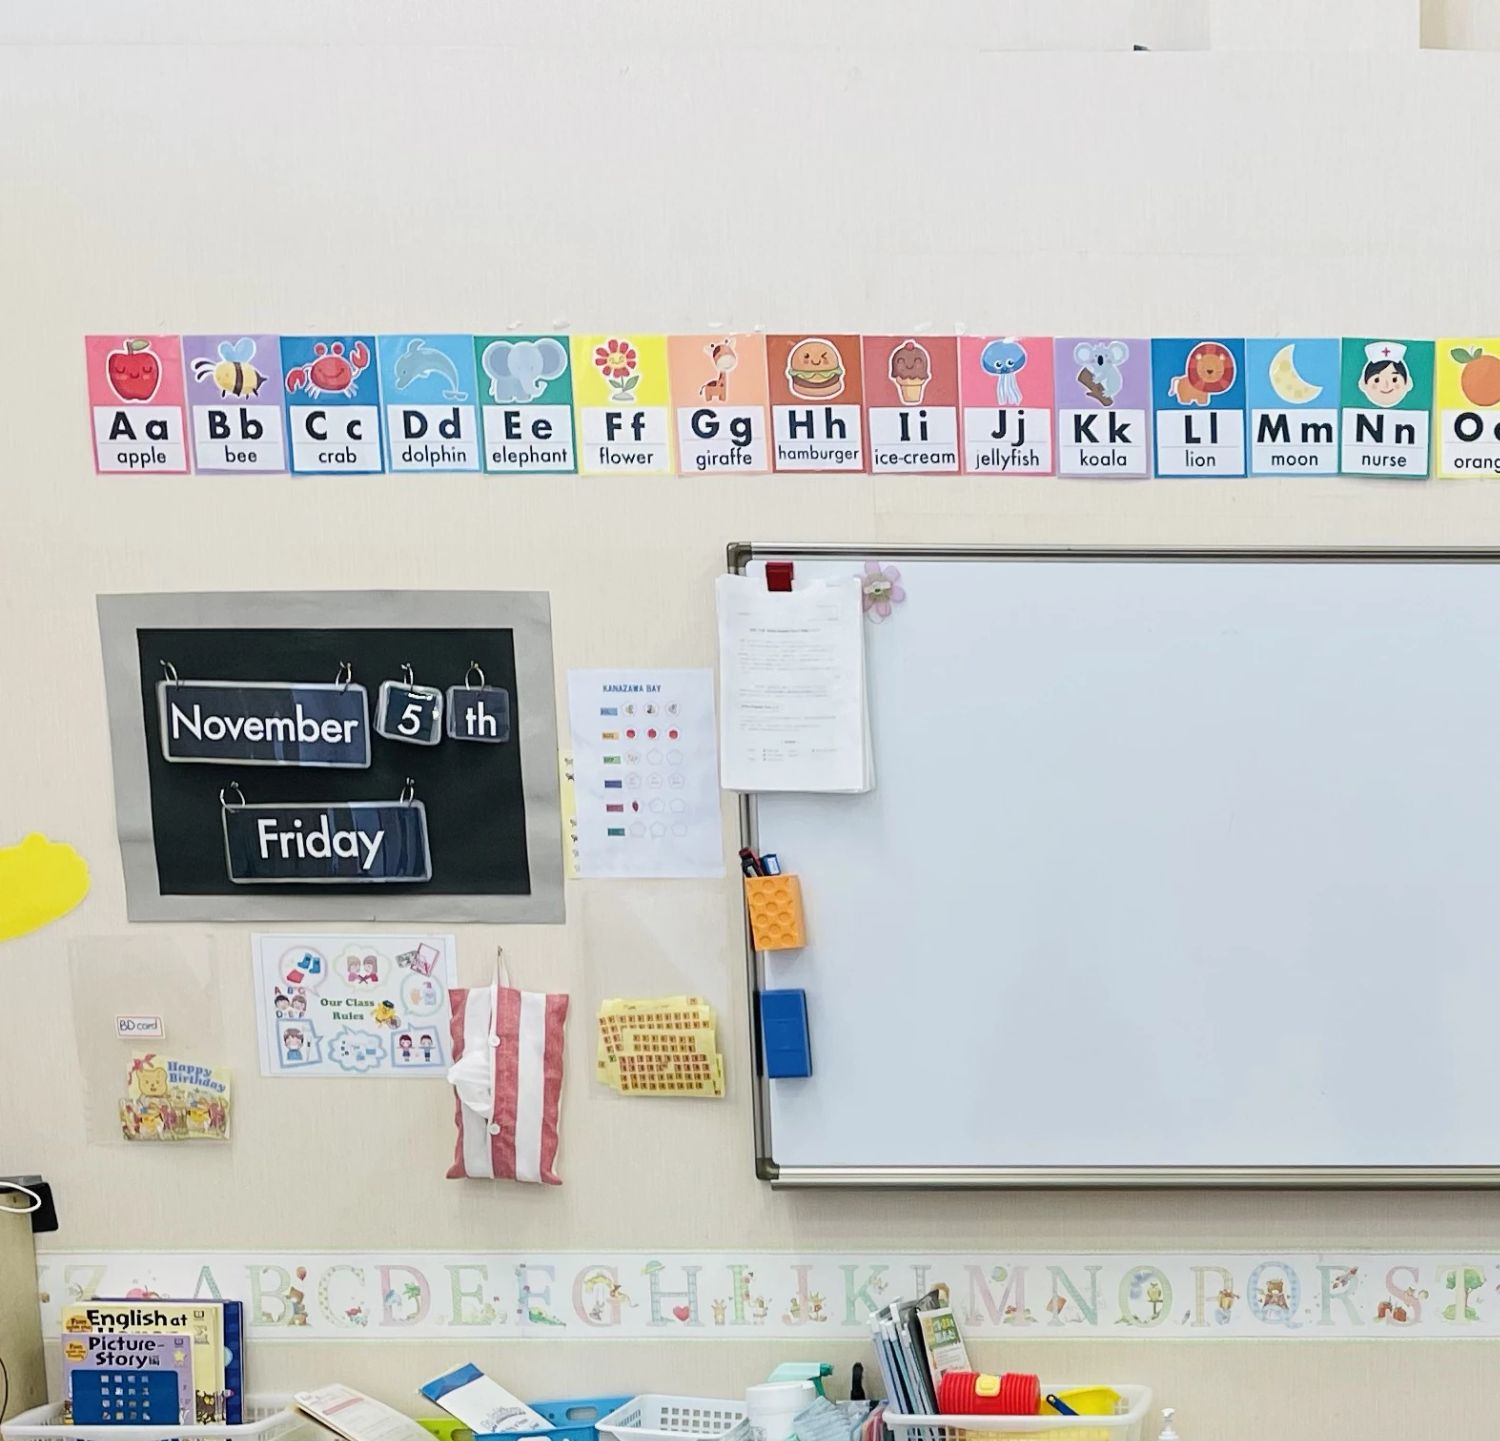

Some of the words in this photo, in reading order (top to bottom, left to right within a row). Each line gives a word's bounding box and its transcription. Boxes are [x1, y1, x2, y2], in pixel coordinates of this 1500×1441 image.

[117, 446, 166, 467] apple
[225, 445, 257, 463] bee
[318, 446, 357, 464] crab
[402, 444, 467, 467] dolphin
[492, 445, 568, 468] elephant
[599, 447, 654, 465] flower
[696, 447, 753, 470] giraffe
[778, 445, 860, 465] hamburger
[874, 449, 956, 466] ice-cream
[974, 448, 1040, 471] jellyfish
[1080, 449, 1127, 466] koala
[1185, 450, 1216, 467] lion
[1271, 454, 1319, 466] moon
[1361, 455, 1407, 467] nurse
[602, 684, 645, 694] KANAZAWA
[171, 699, 360, 745] November
[397, 701, 423, 737] 5
[464, 700, 499, 738] th
[257, 818, 386, 871] Friday
[320, 997, 343, 1008] Our
[344, 997, 375, 1008] Class
[332, 1011, 365, 1021] Rules
[167, 1060, 213, 1078] Happy
[169, 1072, 227, 1094] Birthday
[87, 1309, 168, 1330] English
[170, 1317, 188, 1327] at
[88, 1336, 165, 1352] Picture-
[95, 1352, 148, 1369] Story
